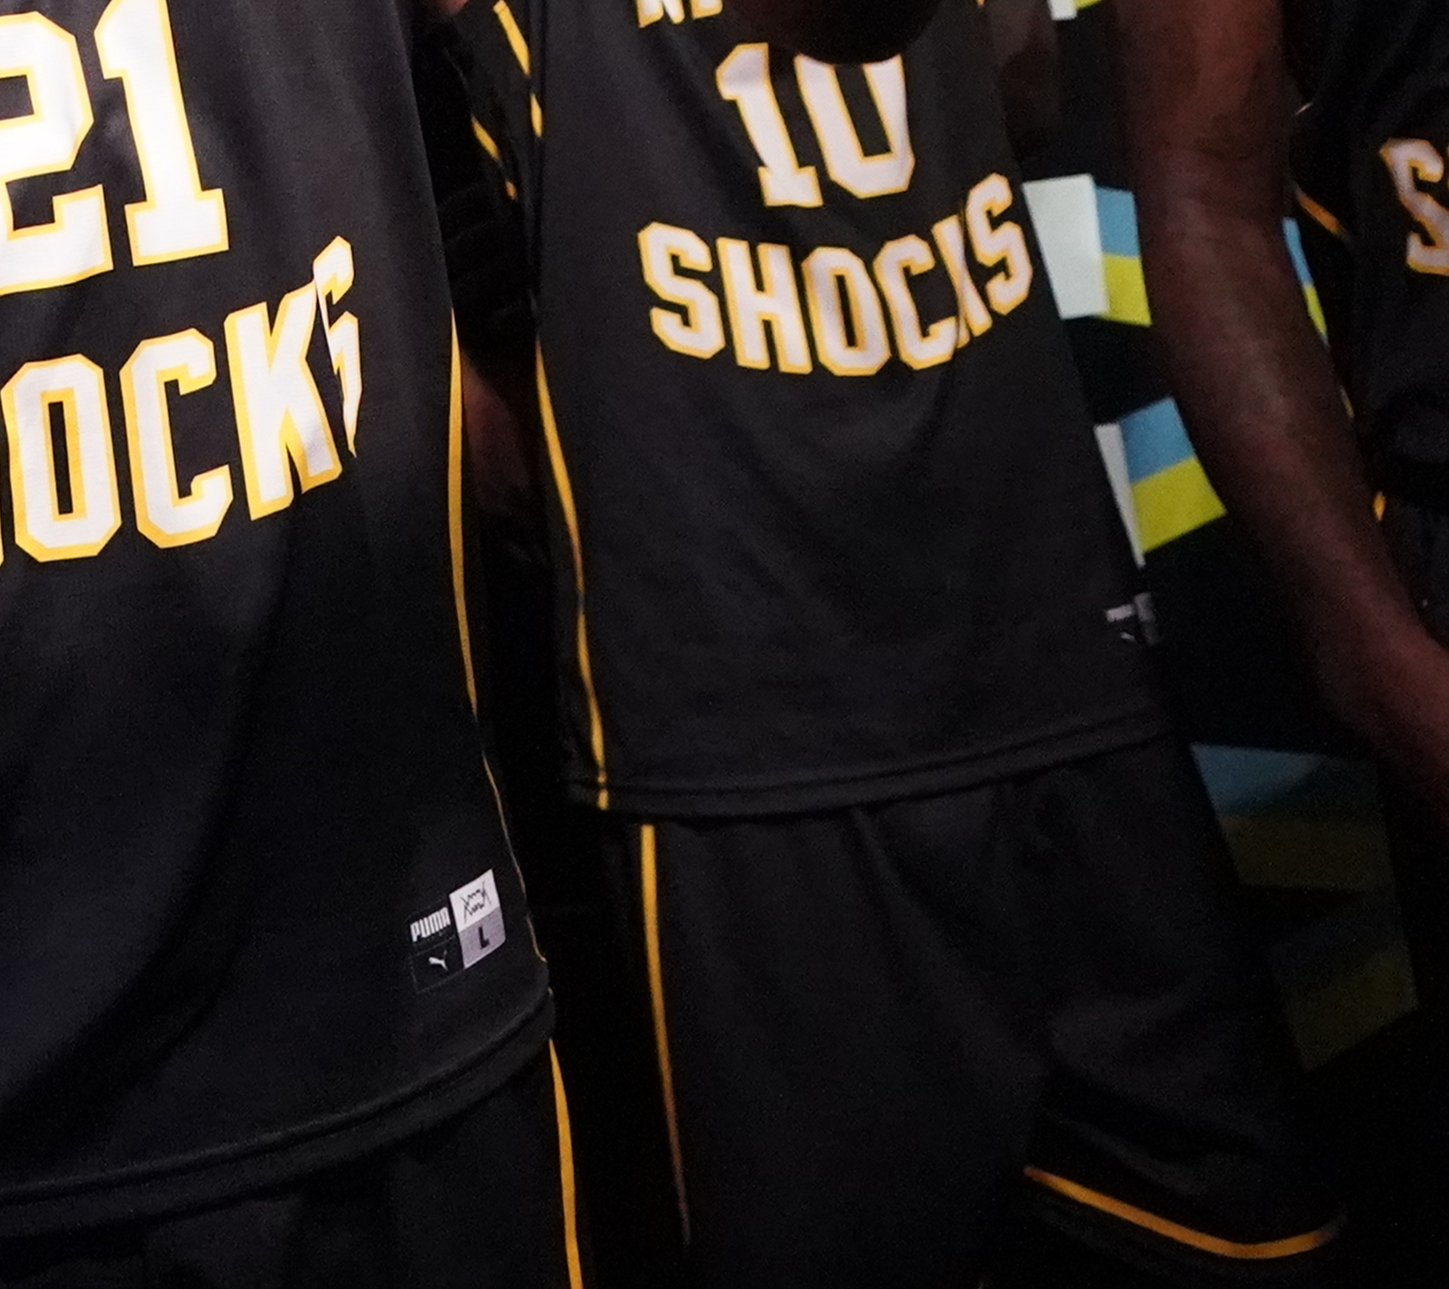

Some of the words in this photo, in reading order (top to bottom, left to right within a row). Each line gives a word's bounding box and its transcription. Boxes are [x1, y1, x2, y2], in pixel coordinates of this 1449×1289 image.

[716, 42, 916, 208] 10
[637, 172, 1034, 377] SHOCKS
[410, 906, 451, 942] PUMA
